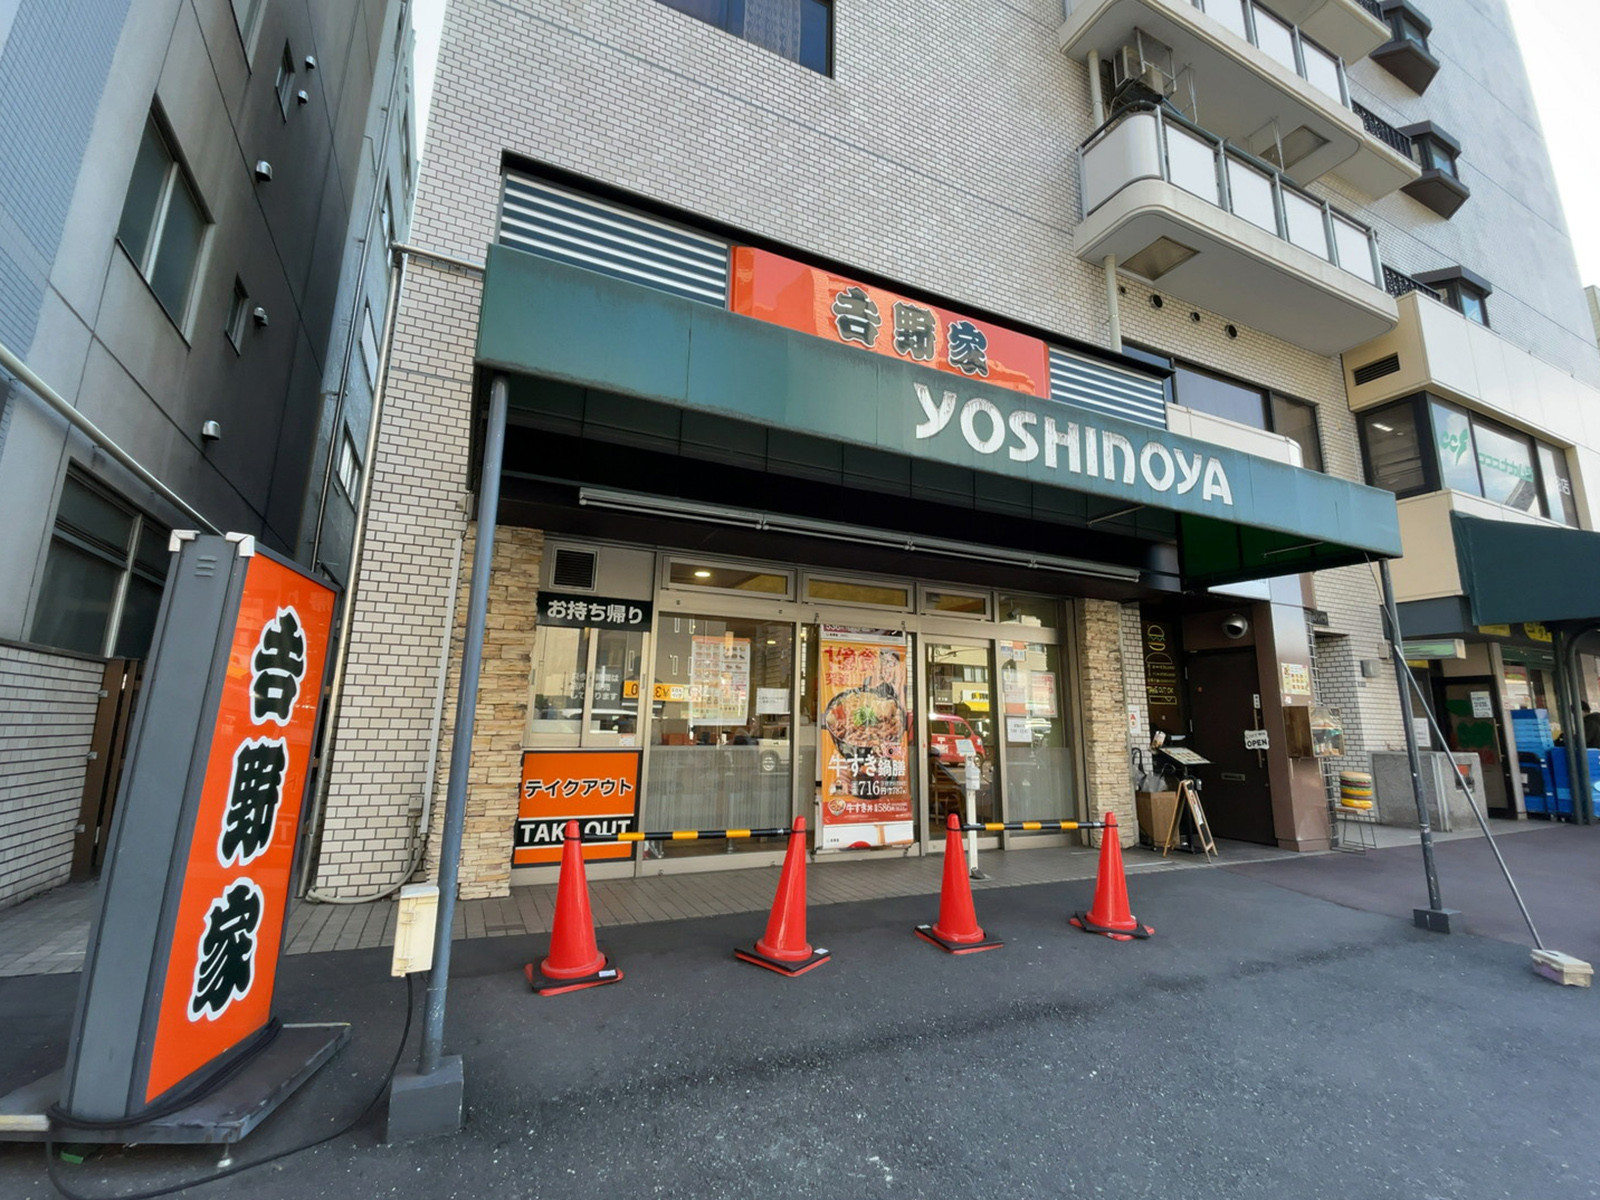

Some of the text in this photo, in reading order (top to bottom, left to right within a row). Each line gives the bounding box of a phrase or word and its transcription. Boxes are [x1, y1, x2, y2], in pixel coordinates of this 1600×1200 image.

[832, 286, 989, 378] 吉野家
[913, 382, 1233, 506] YOSHINOYA
[546, 599, 643, 625] お持ち帰り
[1246, 739, 1268, 748] OPEN
[828, 754, 906, 778] 牛すき鍋膳
[524, 777, 633, 799] テイクアウト
[187, 605, 307, 1022] 吉野家
[520, 822, 567, 843] TAK
